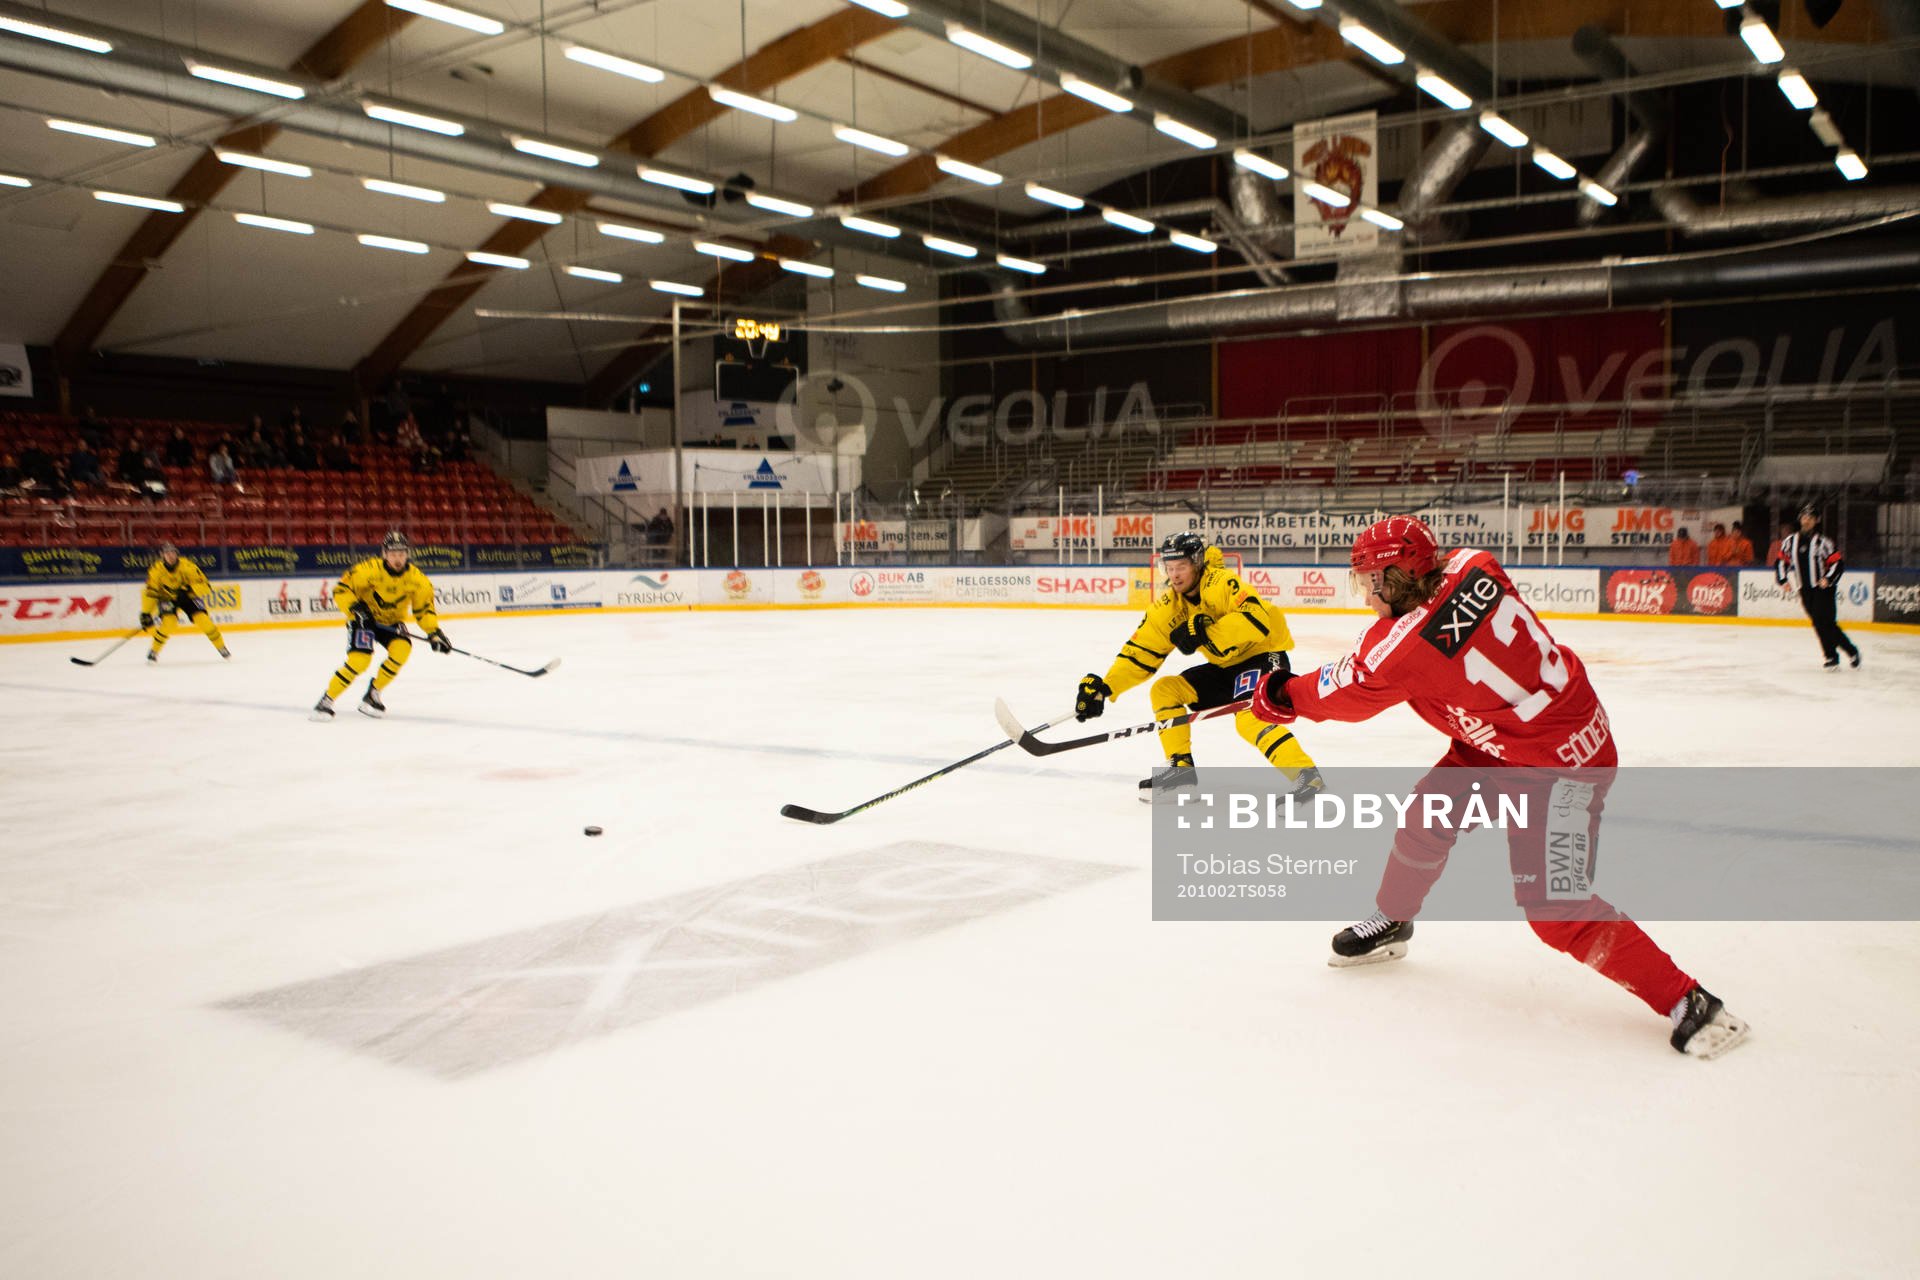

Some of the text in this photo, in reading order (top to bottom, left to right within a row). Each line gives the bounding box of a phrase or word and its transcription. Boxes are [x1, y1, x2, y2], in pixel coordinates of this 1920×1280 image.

[1559, 319, 1898, 415] VEOLIA
[893, 381, 1162, 449] VEOLIA
[1053, 516, 1095, 537] JMG
[1113, 516, 1153, 536] JMG
[1528, 508, 1585, 532] JMG
[1611, 507, 1674, 532] JMG
[843, 523, 879, 541] JMG
[1113, 537, 1139, 547] STEN
[1565, 533, 1585, 544] AB
[1611, 533, 1674, 545] STEN AB
[1376, 550, 1399, 559] CCM
[956, 576, 1031, 586] HELGESSONS
[1037, 577, 1126, 594] SHARP
[1249, 571, 1272, 584] ICA
[1303, 571, 1327, 585] ICA
[617, 591, 684, 604] FYRISHOV
[956, 587, 1008, 598] CATERING
[1517, 582, 1595, 604] Reklam
[1615, 581, 1666, 605] mix
[1692, 584, 1727, 602] mix
[0, 595, 112, 620] CM
[1440, 577, 1498, 643] xite
[1397, 609, 1423, 633] Motor
[1107, 718, 1175, 742] CCM
[1574, 832, 1586, 852] AB
[1550, 831, 1571, 892] BWN
[1514, 874, 1537, 884] CM
